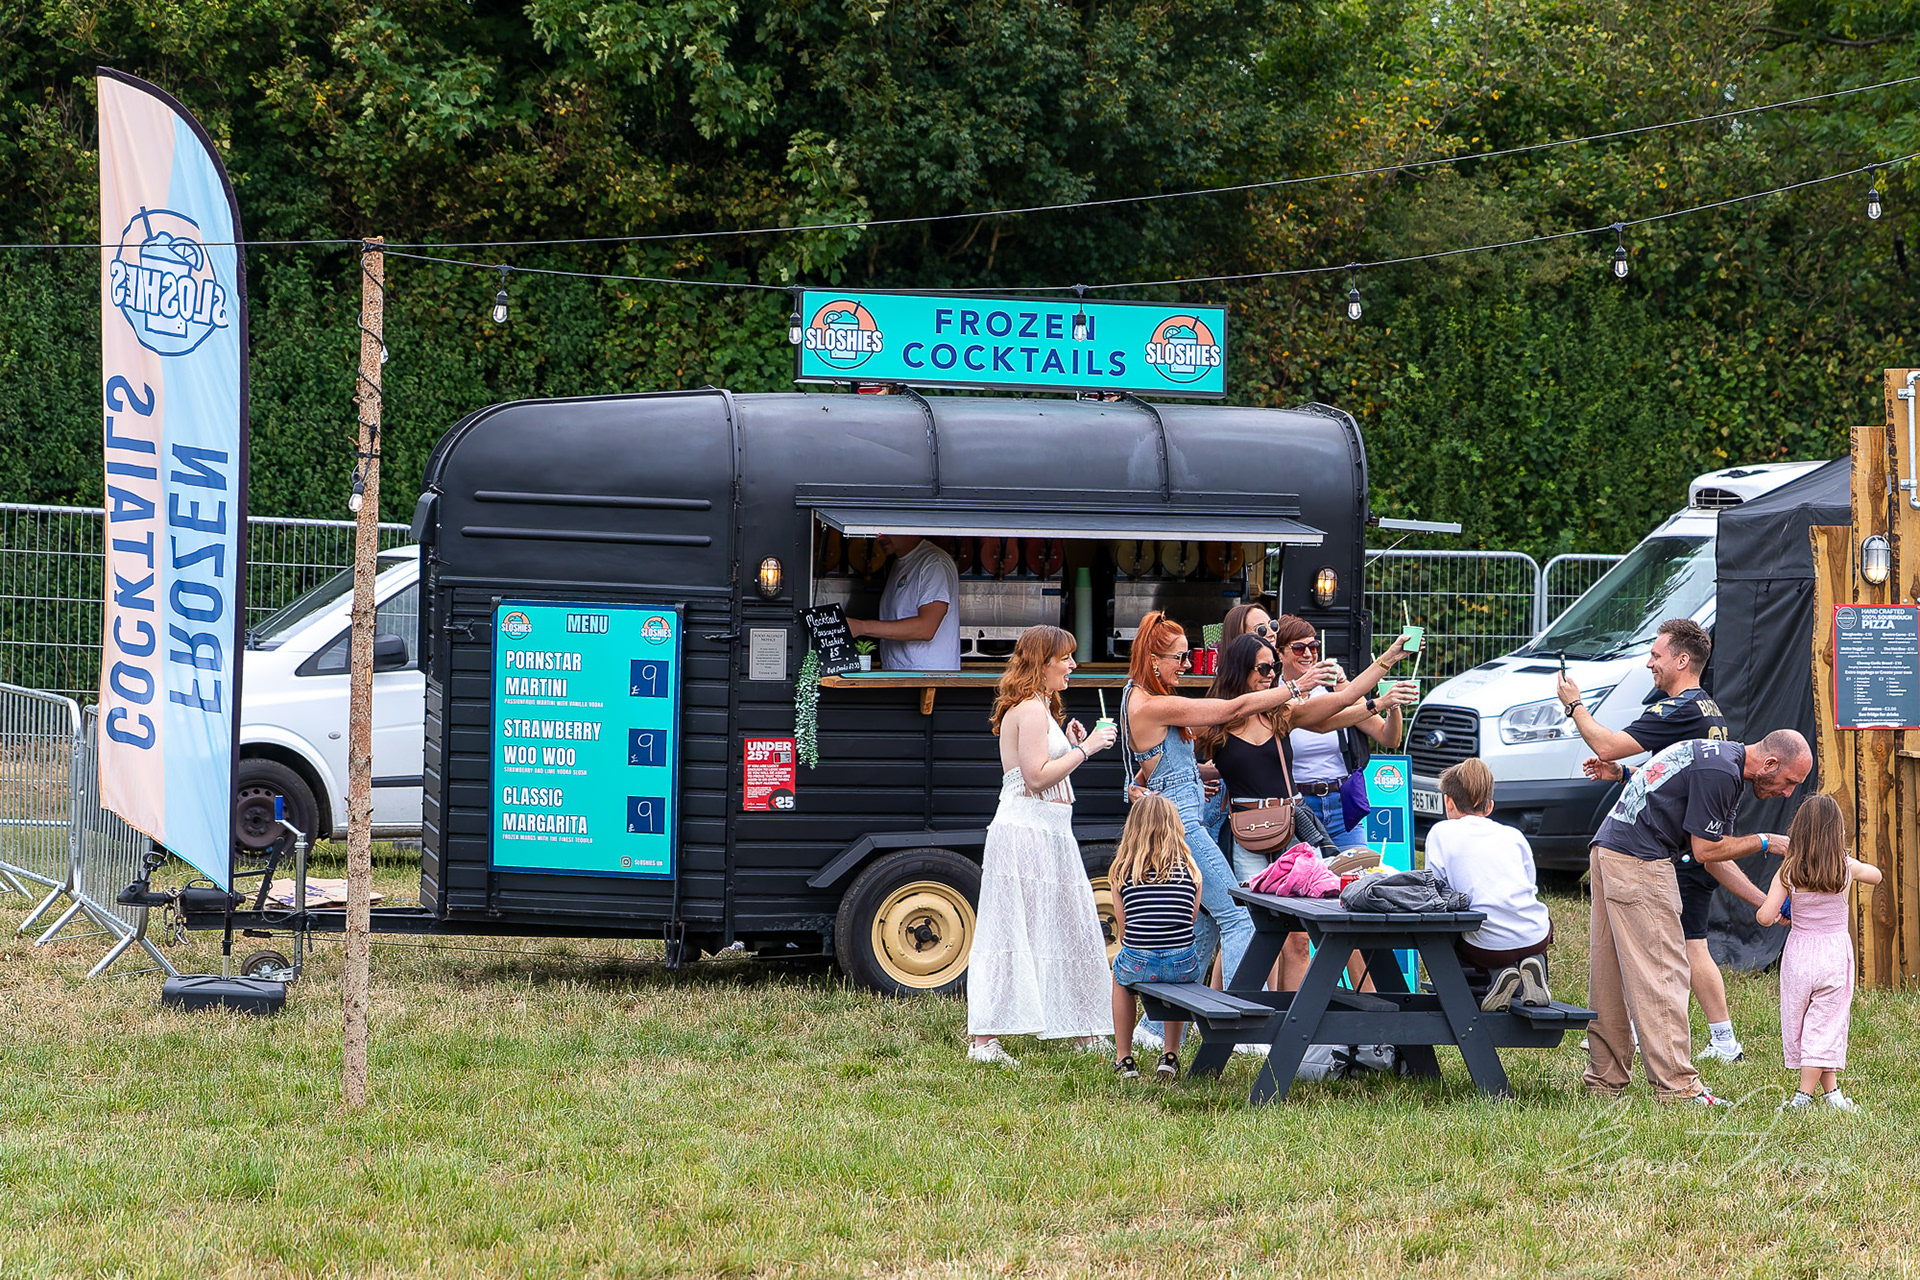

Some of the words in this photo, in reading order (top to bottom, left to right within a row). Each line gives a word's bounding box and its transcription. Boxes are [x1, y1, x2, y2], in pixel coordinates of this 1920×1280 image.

[935, 308, 1096, 341] FROZEN
[805, 328, 884, 354] SLOSHIES
[902, 341, 1127, 377] COCKTAILS
[1144, 341, 1222, 368] SLOSHIES
[501, 622, 533, 633] SLOSHIES
[566, 613, 610, 634] MENU
[805, 610, 840, 628] Mocktail
[1862, 620, 1895, 629] PIZZA
[640, 628, 672, 638] SLOSHIES
[506, 650, 582, 672] PORNSTAR
[505, 676, 568, 697] MARTINI
[503, 718, 602, 741] STRAWBERRY
[503, 745, 537, 765] WOO
[542, 746, 576, 767] WOO
[747, 741, 792, 751] UNDER
[747, 751, 770, 761] 25?
[1374, 776, 1404, 786] SLOSHIES
[502, 786, 564, 808] CLASSIC
[776, 796, 794, 808] 25
[502, 812, 588, 835] MARGARITA
